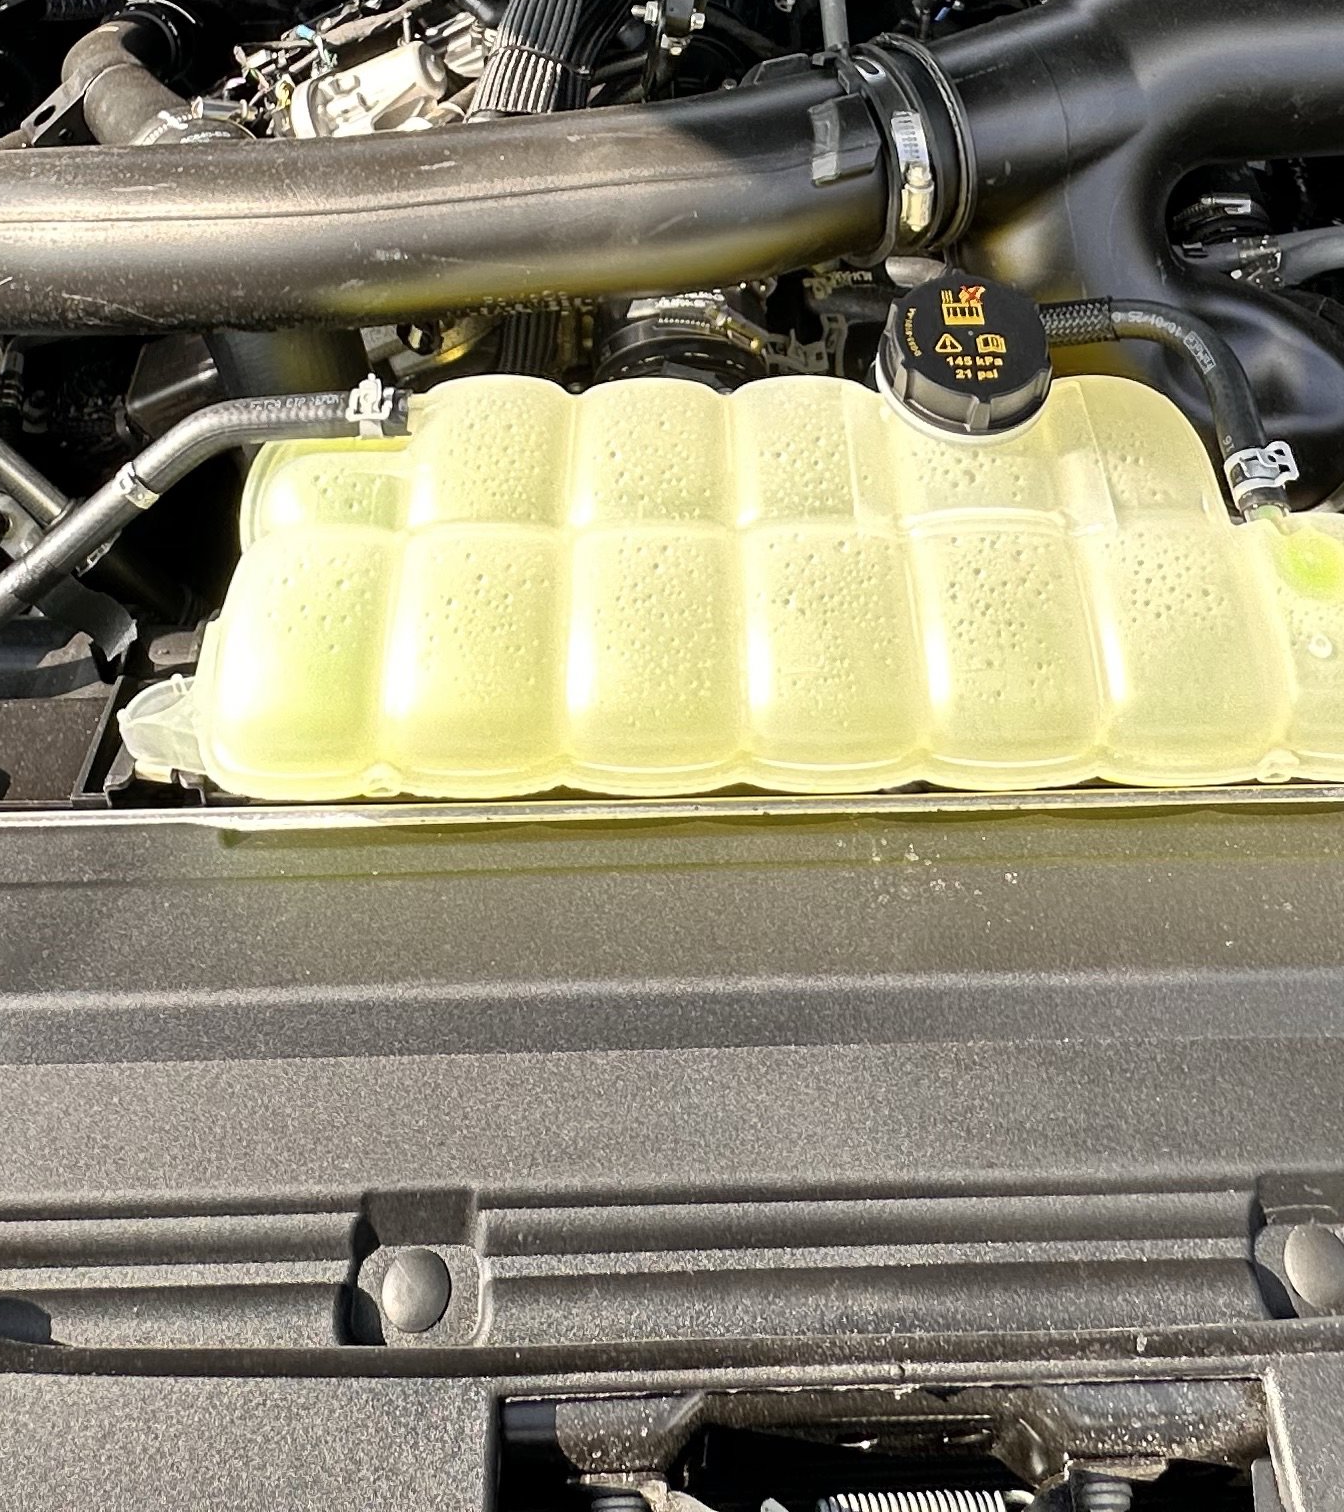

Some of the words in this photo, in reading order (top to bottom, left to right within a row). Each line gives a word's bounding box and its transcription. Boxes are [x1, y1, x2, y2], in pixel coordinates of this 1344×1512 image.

[946, 356, 972, 367] 145
[975, 356, 1004, 367] kPa
[955, 369, 972, 379] 21
[977, 369, 999, 381] psi
